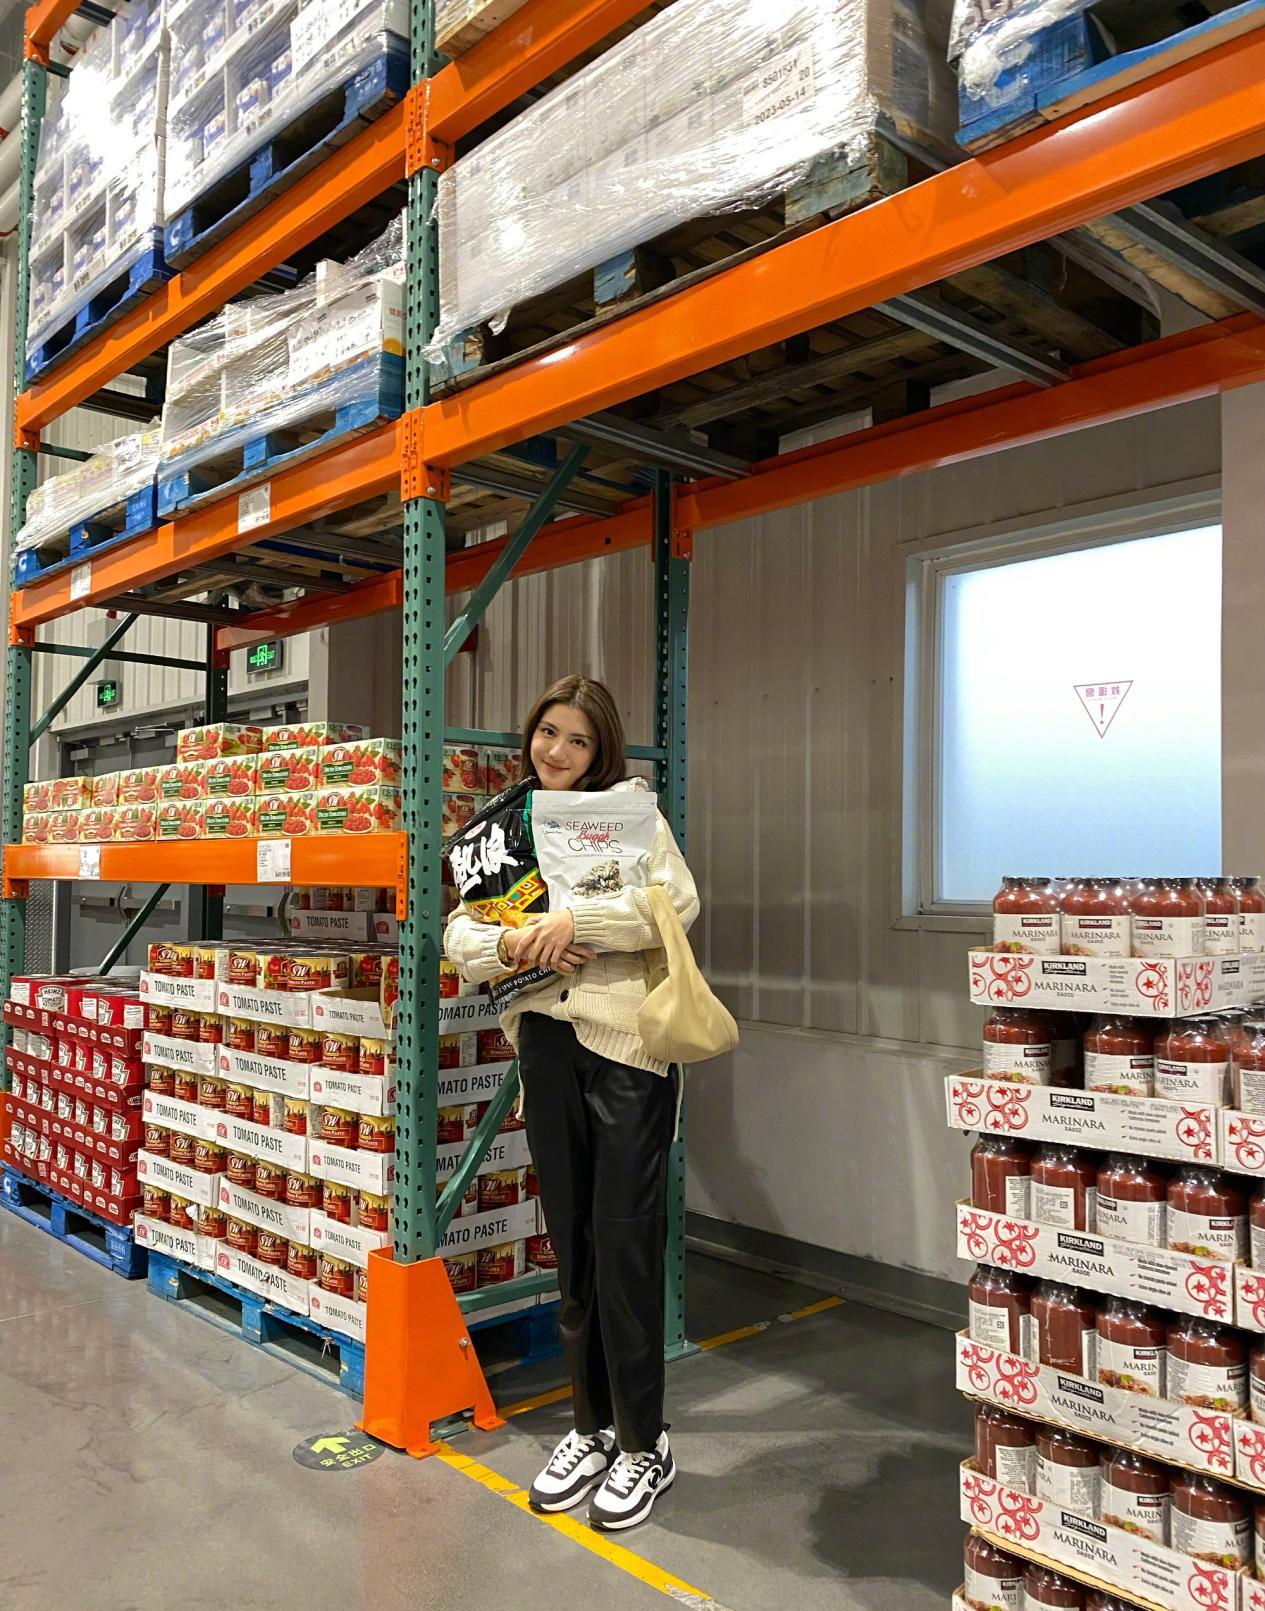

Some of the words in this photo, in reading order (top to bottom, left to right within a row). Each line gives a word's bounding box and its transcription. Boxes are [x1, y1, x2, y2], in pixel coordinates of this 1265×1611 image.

[800, 66, 810, 81] 20
[754, 86, 806, 125] 2023-05-14
[566, 822, 623, 831] SEAWEED
[568, 838, 622, 854] CHIPS
[307, 916, 329, 928] TOMATO
[330, 917, 349, 929] PASTE
[1044, 962, 1085, 970] KIRKLAND
[513, 973, 537, 986] POTATO
[1034, 981, 1097, 992] MARINARA
[154, 980, 174, 995] TOMATO
[177, 984, 195, 997] PASTE
[233, 996, 259, 1012] TOMATO
[260, 1000, 282, 1016] PASTE
[329, 1010, 349, 1021] TOMATO
[350, 1013, 364, 1023] PASTE
[154, 1045, 174, 1060] TOMATO
[176, 1050, 194, 1063] PASTE
[236, 1057, 262, 1075] TOMATO
[264, 1063, 286, 1081] PASTE
[325, 1080, 346, 1092] TOMATO
[347, 1084, 361, 1094] PASTE
[438, 1078, 467, 1095] MATO
[472, 1073, 504, 1090] PASTE
[1051, 1095, 1094, 1106] KIRKLAND
[156, 1103, 178, 1120] TOMATO
[179, 1111, 197, 1126] PASTE
[1042, 1114, 1106, 1130] MARINARA
[233, 1126, 259, 1145] TOMATO
[261, 1134, 282, 1153] PASTE
[323, 1156, 344, 1166] TOMATO
[346, 1161, 361, 1174] PASTE
[436, 1154, 461, 1172] MAT
[482, 1146, 505, 1162] STE
[153, 1162, 174, 1180] TOMATO
[175, 1172, 193, 1188] PASTE
[233, 1194, 259, 1215] TOMATO
[262, 1206, 283, 1226] PASTE
[325, 1230, 344, 1245] TOMATO
[345, 1238, 361, 1250] PASTE
[437, 1228, 470, 1248] MATO
[474, 1219, 508, 1240] PASTE
[1060, 1234, 1103, 1250] KIRKLAND
[1197, 1232, 1234, 1241] MARIN
[151, 1230, 173, 1248] TOMATO
[175, 1238, 196, 1255] PASTE
[1048, 1252, 1115, 1277] MARINARA
[1073, 1268, 1090, 1276] SAUCE
[326, 1306, 346, 1320] TOMATO
[348, 1315, 362, 1329] PASTE
[1123, 1361, 1158, 1371] MARIN
[1060, 1379, 1101, 1397] KIRKLAND
[1051, 1394, 1116, 1424] MARINARA
[1074, 1411, 1092, 1421] SAUCE
[342, 1454, 372, 1467] EXIT
[1127, 1508, 1162, 1519] MARIN
[1064, 1514, 1105, 1536] KIRKLAND
[1054, 1531, 1117, 1565] MARINARA
[1077, 1549, 1095, 1560] SAUCE
[992, 1593, 1016, 1601] MARI
